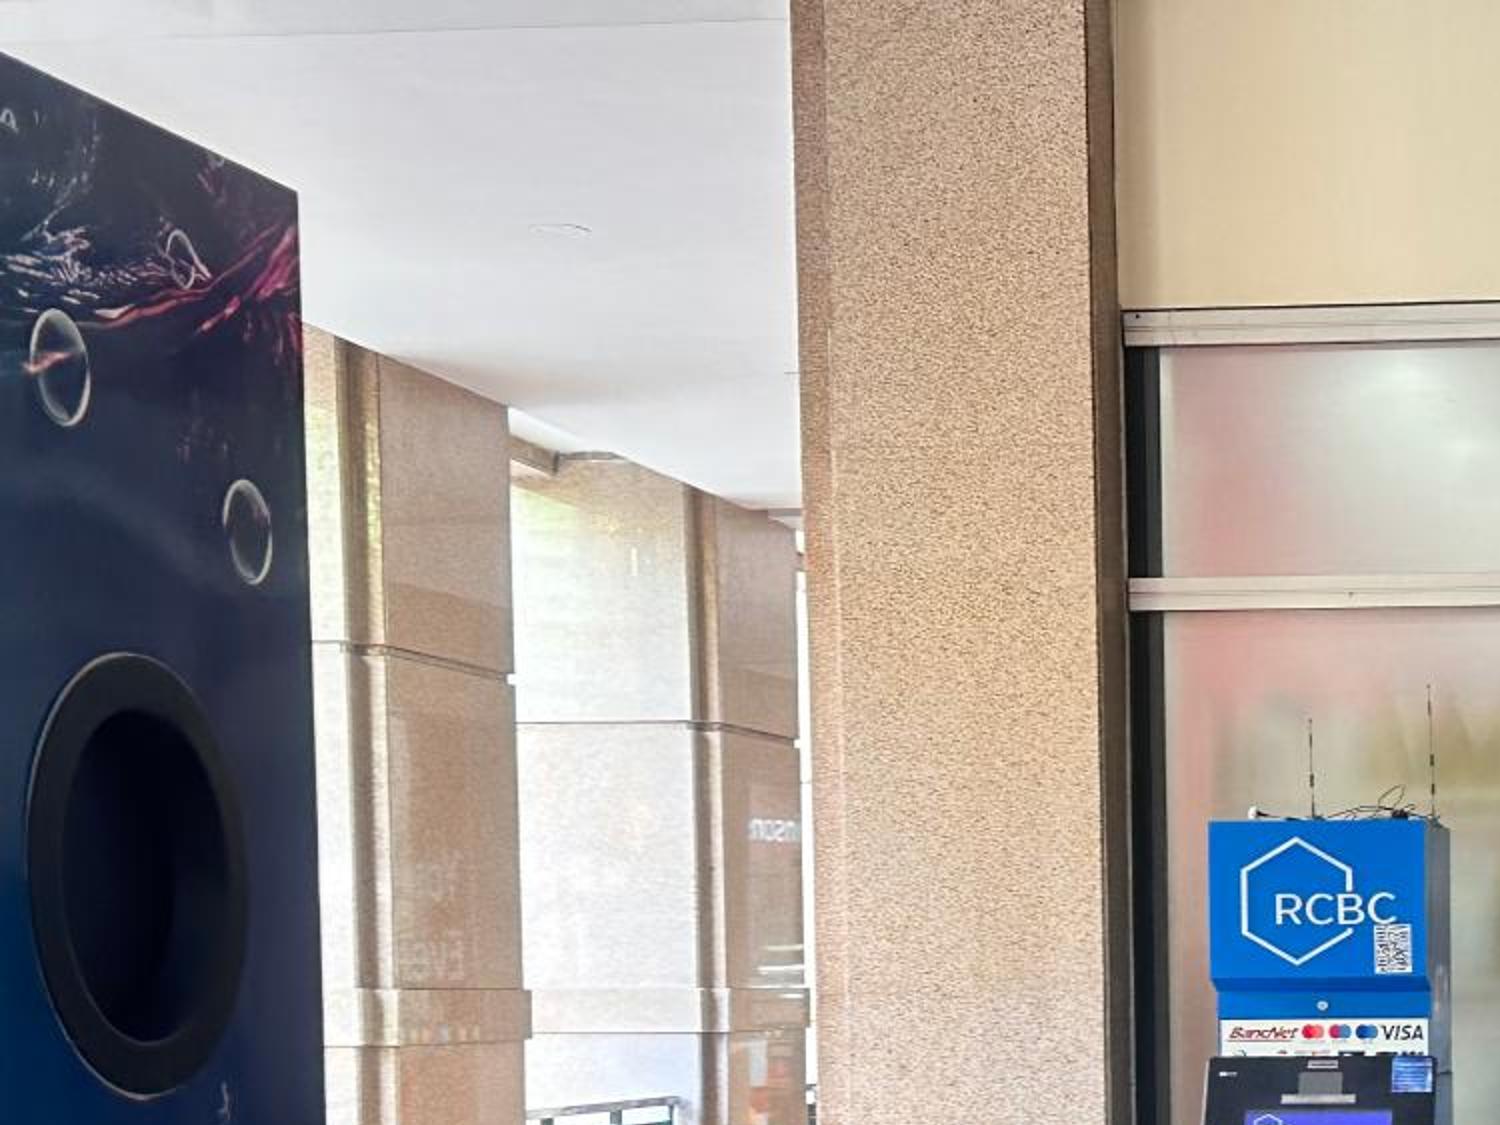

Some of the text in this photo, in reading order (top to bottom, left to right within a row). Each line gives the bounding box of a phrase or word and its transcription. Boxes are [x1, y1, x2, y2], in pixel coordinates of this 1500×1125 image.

[1274, 892, 1397, 925] RCBC
[1228, 1026, 1299, 1040] BancNet
[1381, 1025, 1424, 1041] VISA
